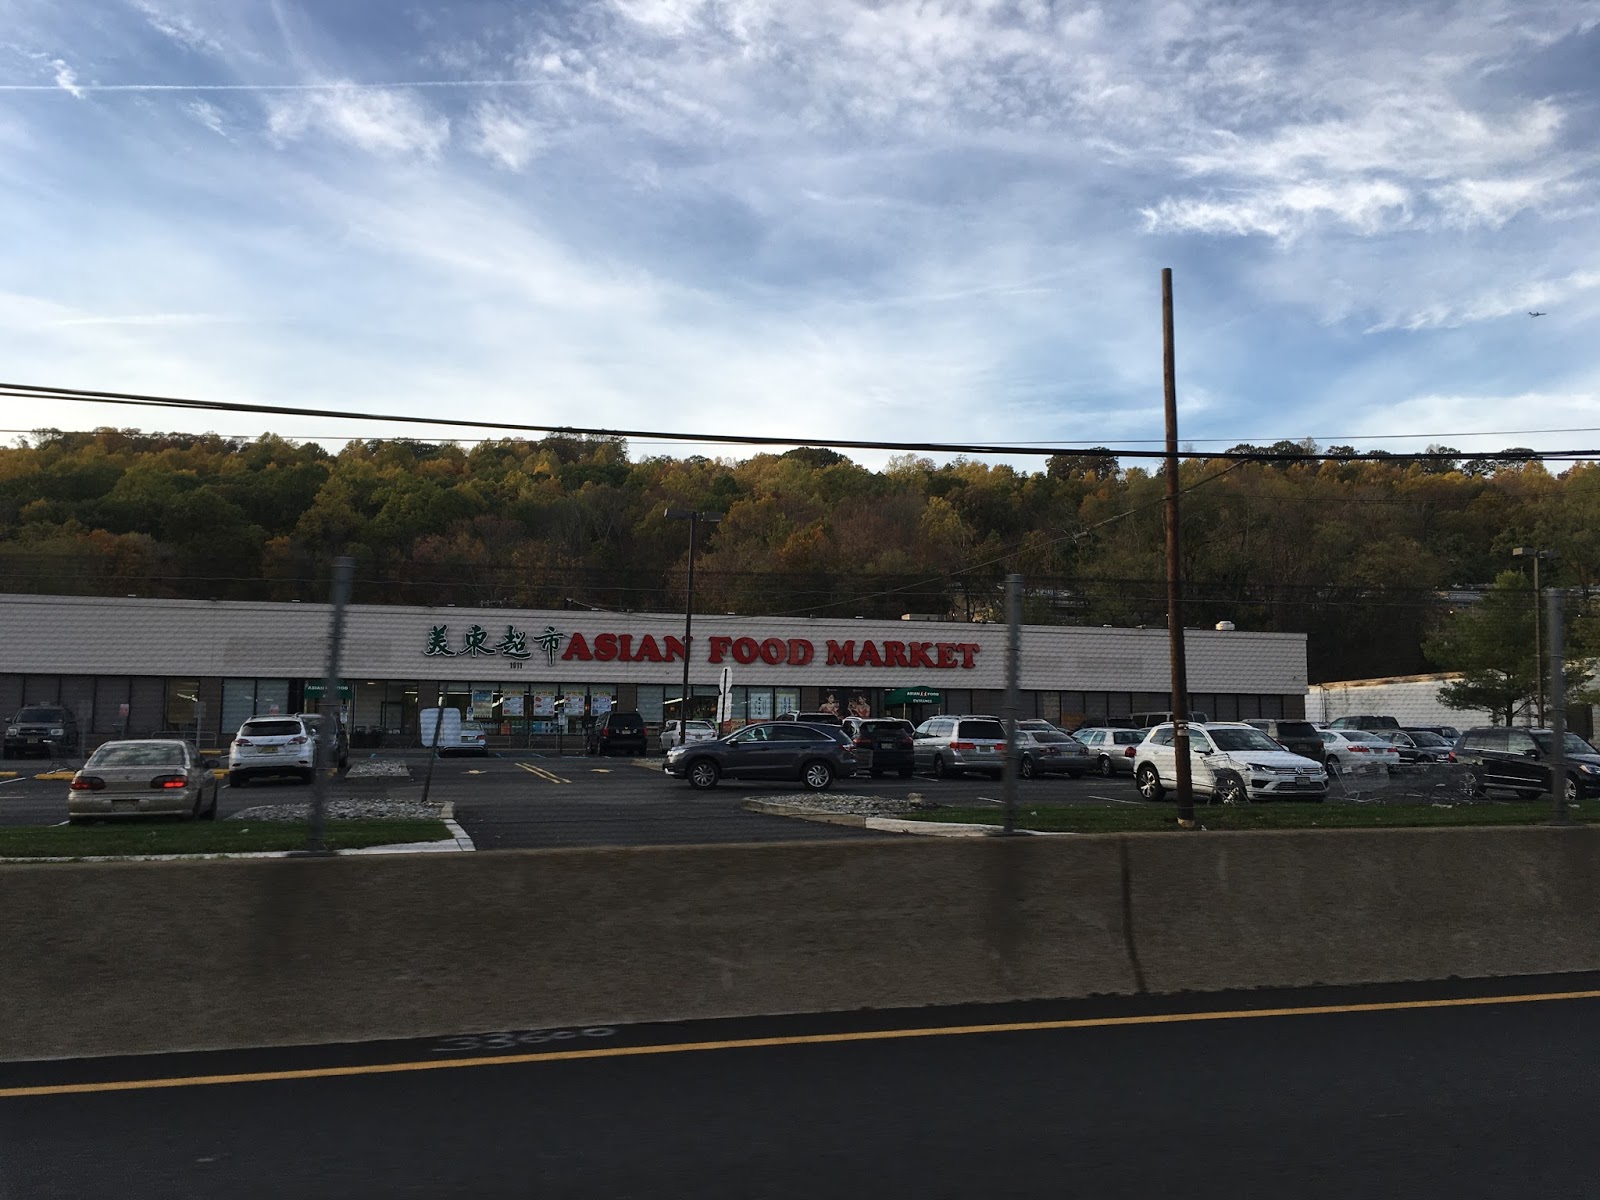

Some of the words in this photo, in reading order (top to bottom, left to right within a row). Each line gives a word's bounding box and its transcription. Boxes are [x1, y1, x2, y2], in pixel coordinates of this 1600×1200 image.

[424, 624, 565, 667] 美東超市
[561, 632, 694, 662] ASIAN
[708, 636, 815, 665] FOOD
[826, 639, 980, 668] MARKET
